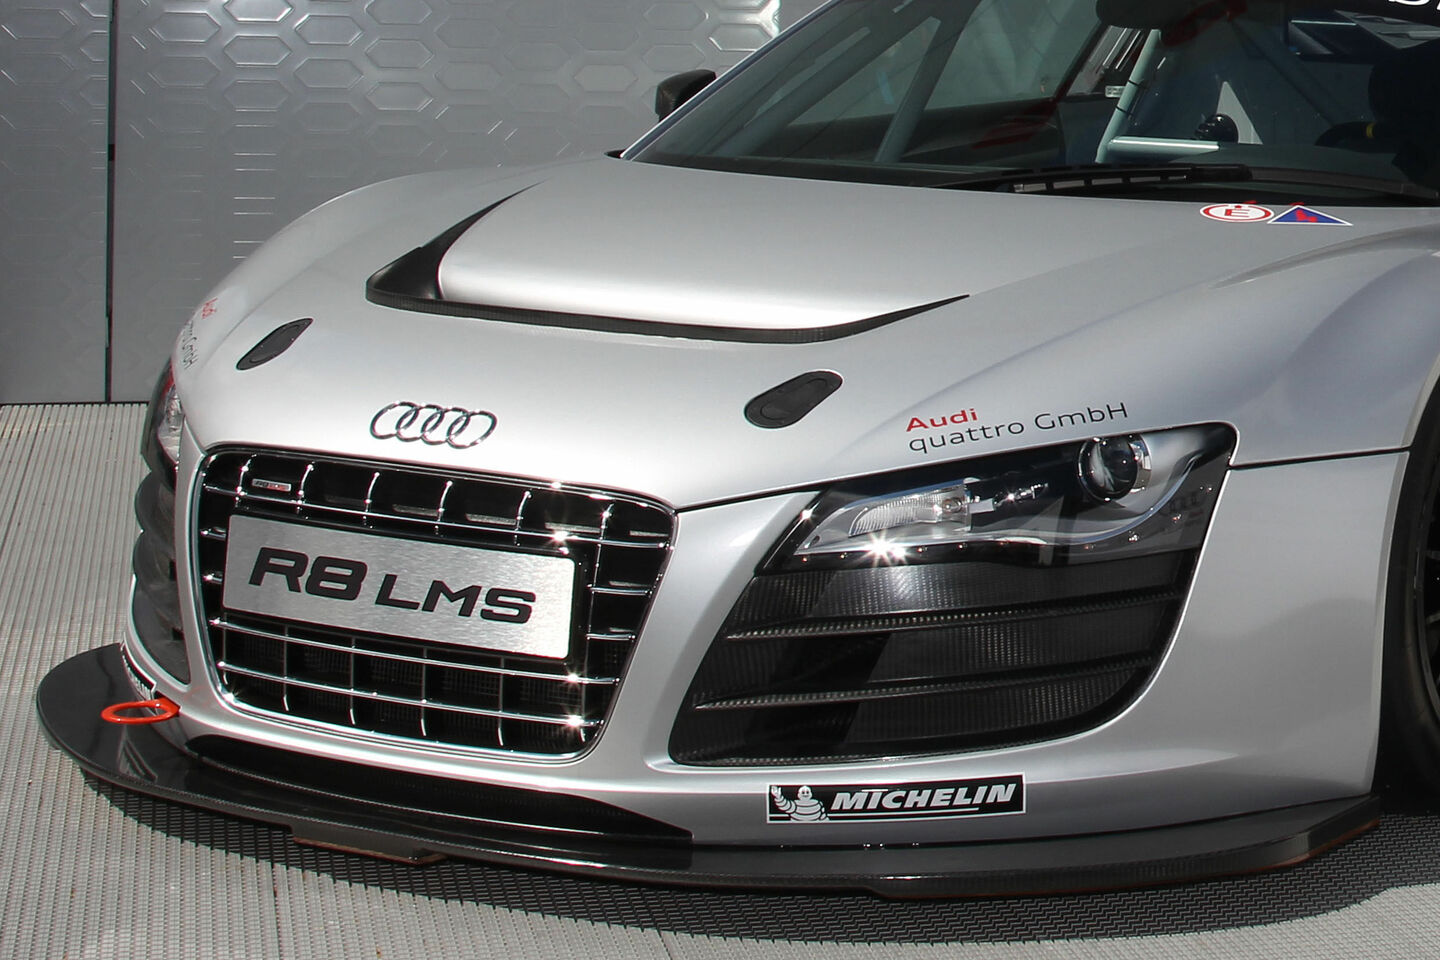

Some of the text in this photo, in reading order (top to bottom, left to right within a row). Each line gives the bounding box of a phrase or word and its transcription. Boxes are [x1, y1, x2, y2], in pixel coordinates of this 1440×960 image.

[905, 407, 979, 432] Audi
[908, 401, 1129, 454] quattro GmbH
[248, 546, 537, 625] R8 LMS
[830, 783, 1017, 811] MICHELIN
